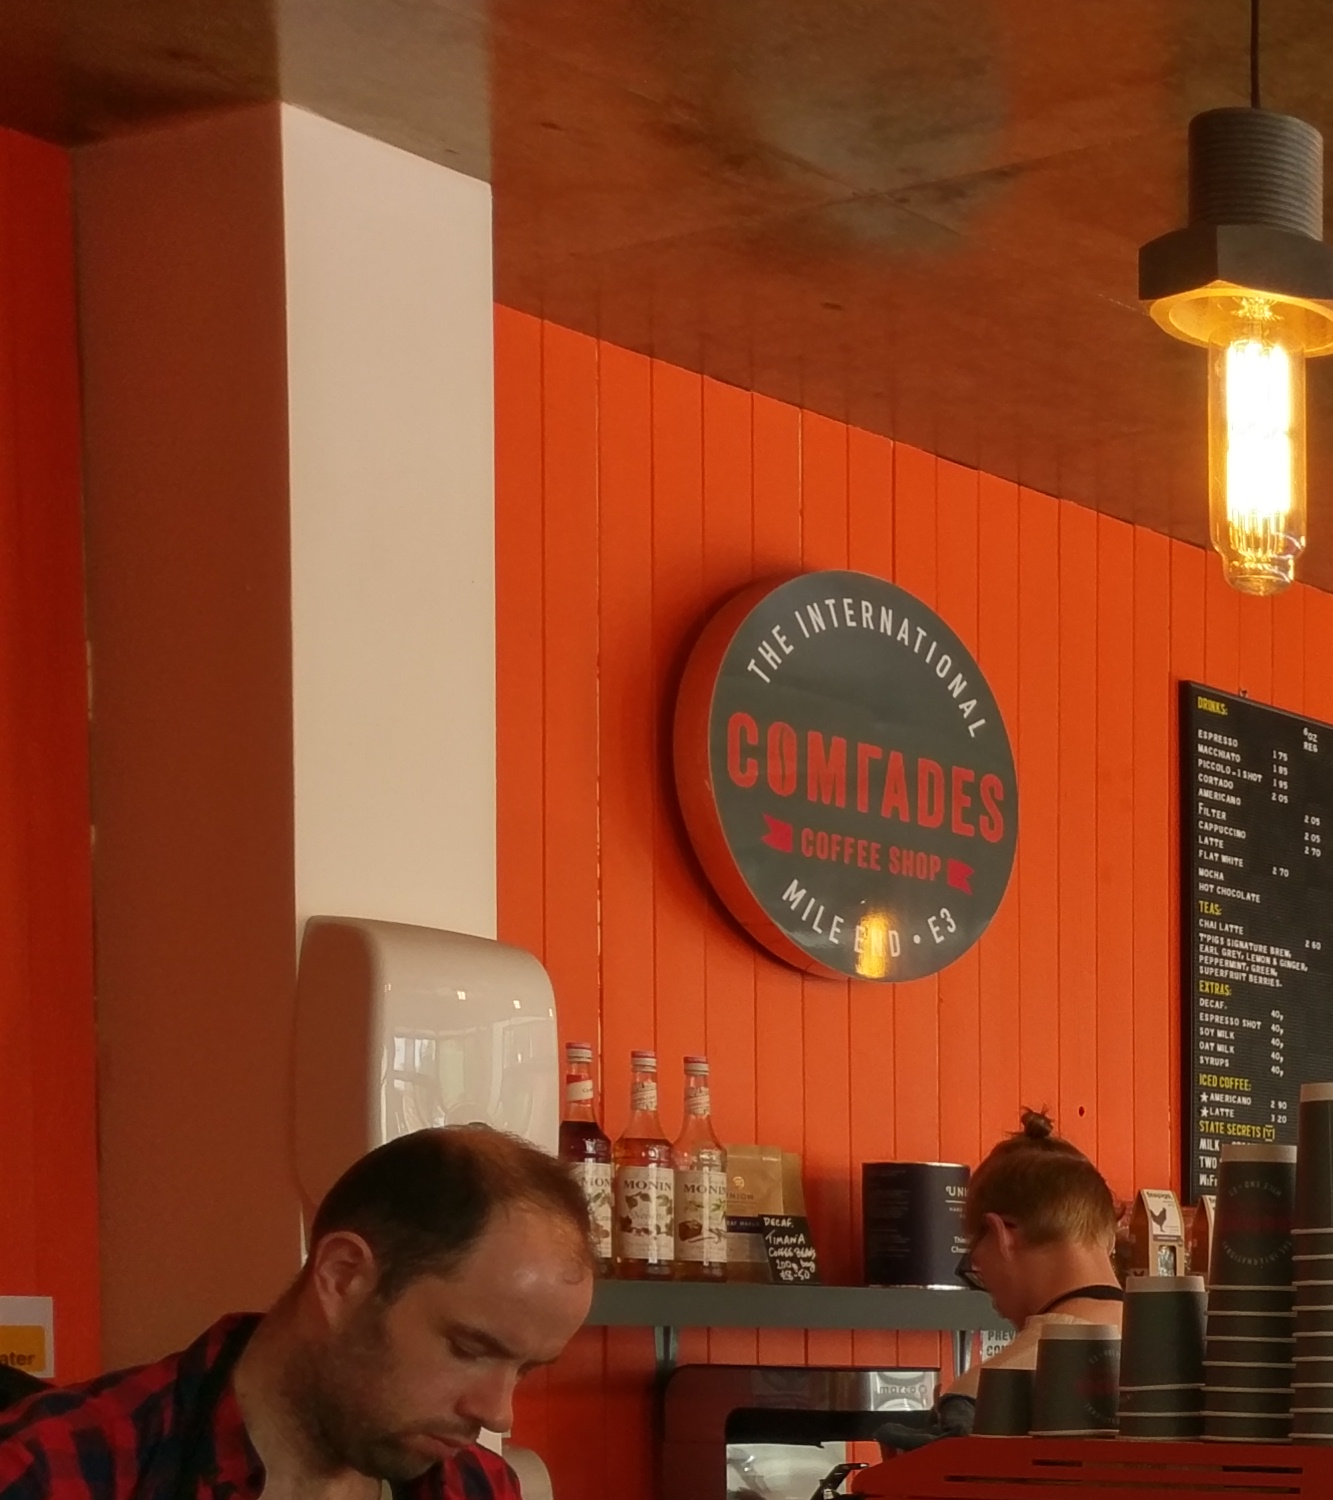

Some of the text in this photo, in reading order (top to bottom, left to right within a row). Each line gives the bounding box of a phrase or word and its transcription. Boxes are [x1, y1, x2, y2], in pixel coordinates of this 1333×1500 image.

[747, 598, 987, 738] THE INTERNATIONAL
[1198, 729, 1239, 748] ESPRESSO
[1197, 743, 1241, 763] MACCHIATO
[1198, 758, 1263, 783] PICCOLO SHOT
[1198, 773, 1234, 790] CORTADO
[1198, 788, 1242, 806] AMERICANO
[1198, 802, 1227, 820] FILTER
[1198, 820, 1247, 839] CAPPUCCINO
[1198, 835, 1224, 849] LATTE
[801, 828, 942, 881] COFFEE SHOP
[1198, 849, 1244, 868] FLAT WHITE
[1198, 867, 1224, 881] MOCHA
[1199, 882, 1261, 903] HOT CHOCOLATE
[782, 879, 846, 945] MILE
[927, 907, 958, 944] E3
[1199, 918, 1244, 935] CHAI LATTE
[1226, 938, 1268, 954] SIGNATURE
[1199, 944, 1219, 956] EARL
[1221, 947, 1245, 960] GREY,
[1246, 952, 1271, 965] LEMON
[1279, 960, 1309, 972] GINGER,
[1199, 954, 1278, 977] PEPPERMINT, GREEN,
[1199, 966, 1247, 981] SUPERFRUIT
[1199, 1012, 1262, 1030] ESPRESSO SHOT
[1199, 1027, 1235, 1040] SOY MILK
[1199, 1041, 1235, 1054] OAT MILK
[1199, 1055, 1229, 1067] SYRUPS
[1199, 1073, 1218, 1087] ICED
[1209, 1092, 1252, 1106] AMERICANO
[1209, 1107, 1235, 1118] LATTE
[1199, 1120, 1261, 1138] STATE SECRETS
[1199, 1138, 1220, 1151] MILK
[1199, 1156, 1217, 1169] TWO
[624, 1179, 672, 1191] MONIN
[987, 1331, 1016, 1341] PREV
[880, 1386, 916, 1395] marco
